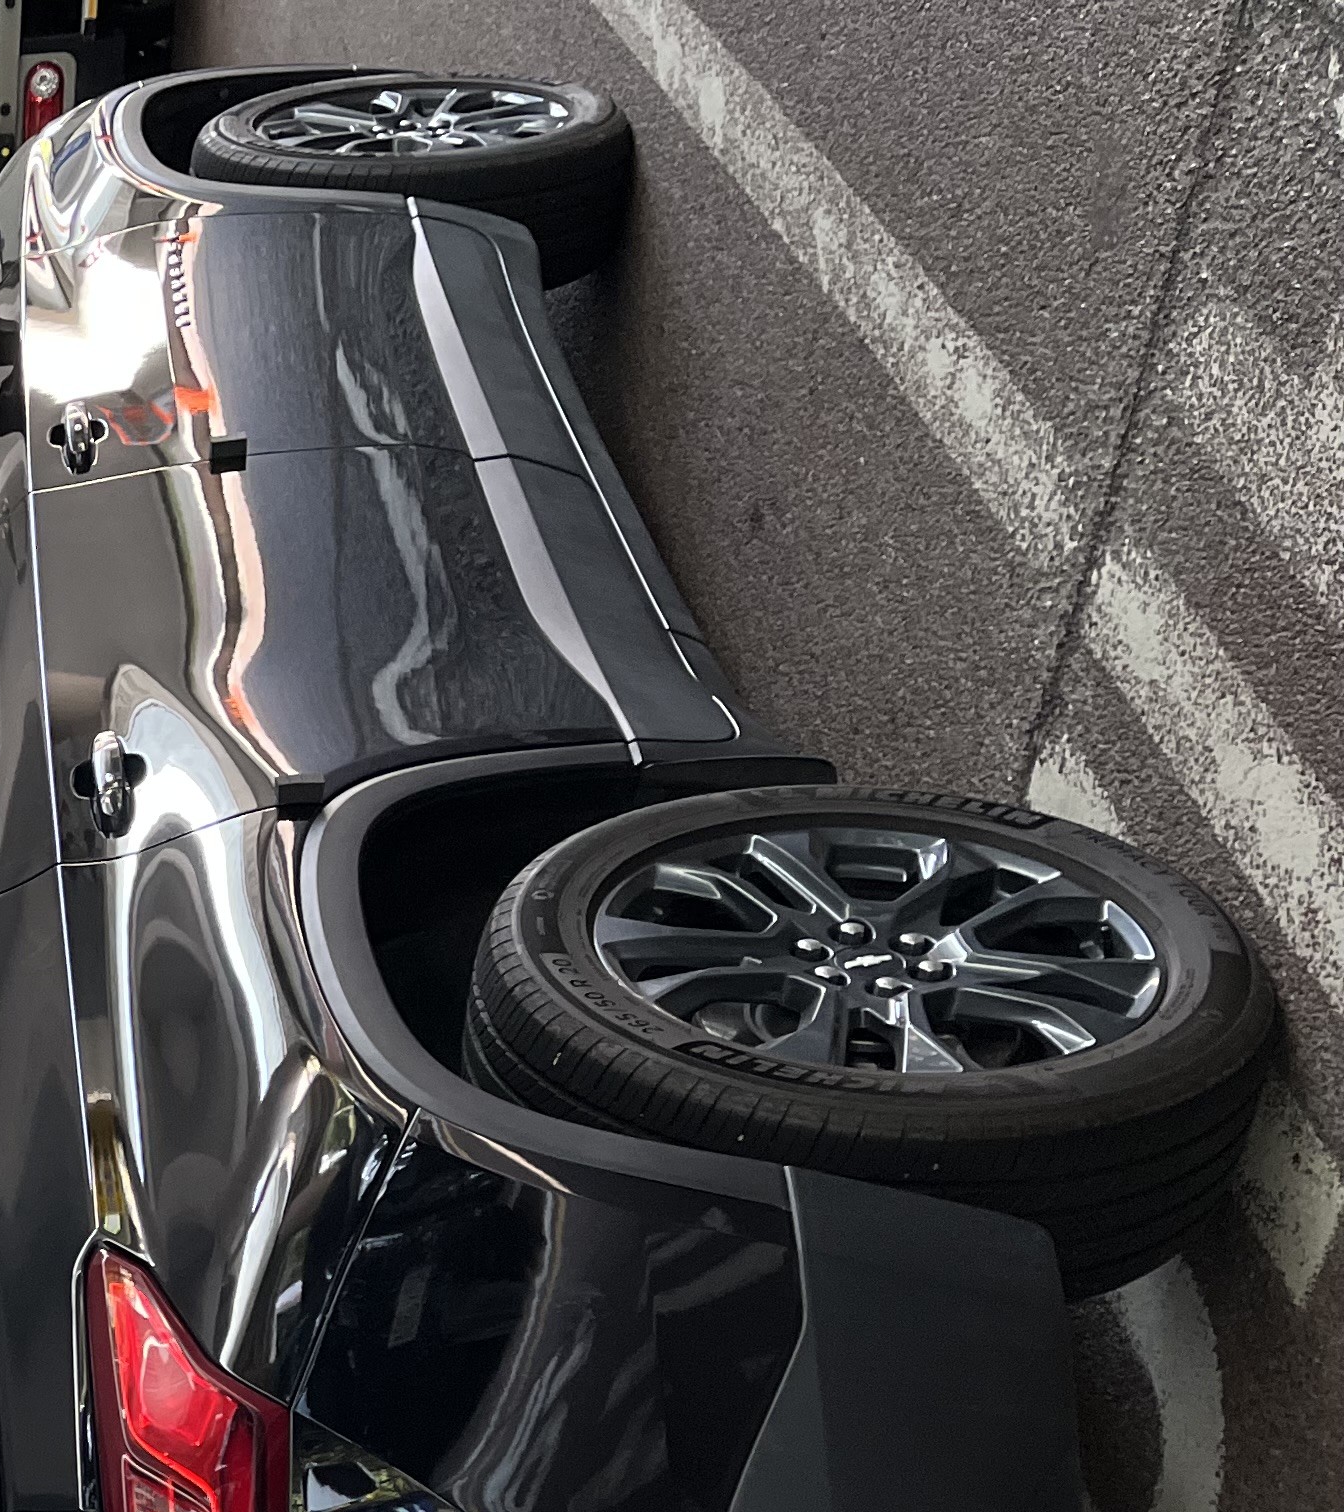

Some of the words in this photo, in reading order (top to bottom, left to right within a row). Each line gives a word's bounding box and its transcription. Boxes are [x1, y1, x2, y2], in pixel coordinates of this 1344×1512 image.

[166, 231, 191, 327] TRAVERS
[551, 957, 580, 975] 20
[570, 978, 593, 988] R
[584, 991, 665, 1034] 265/50
